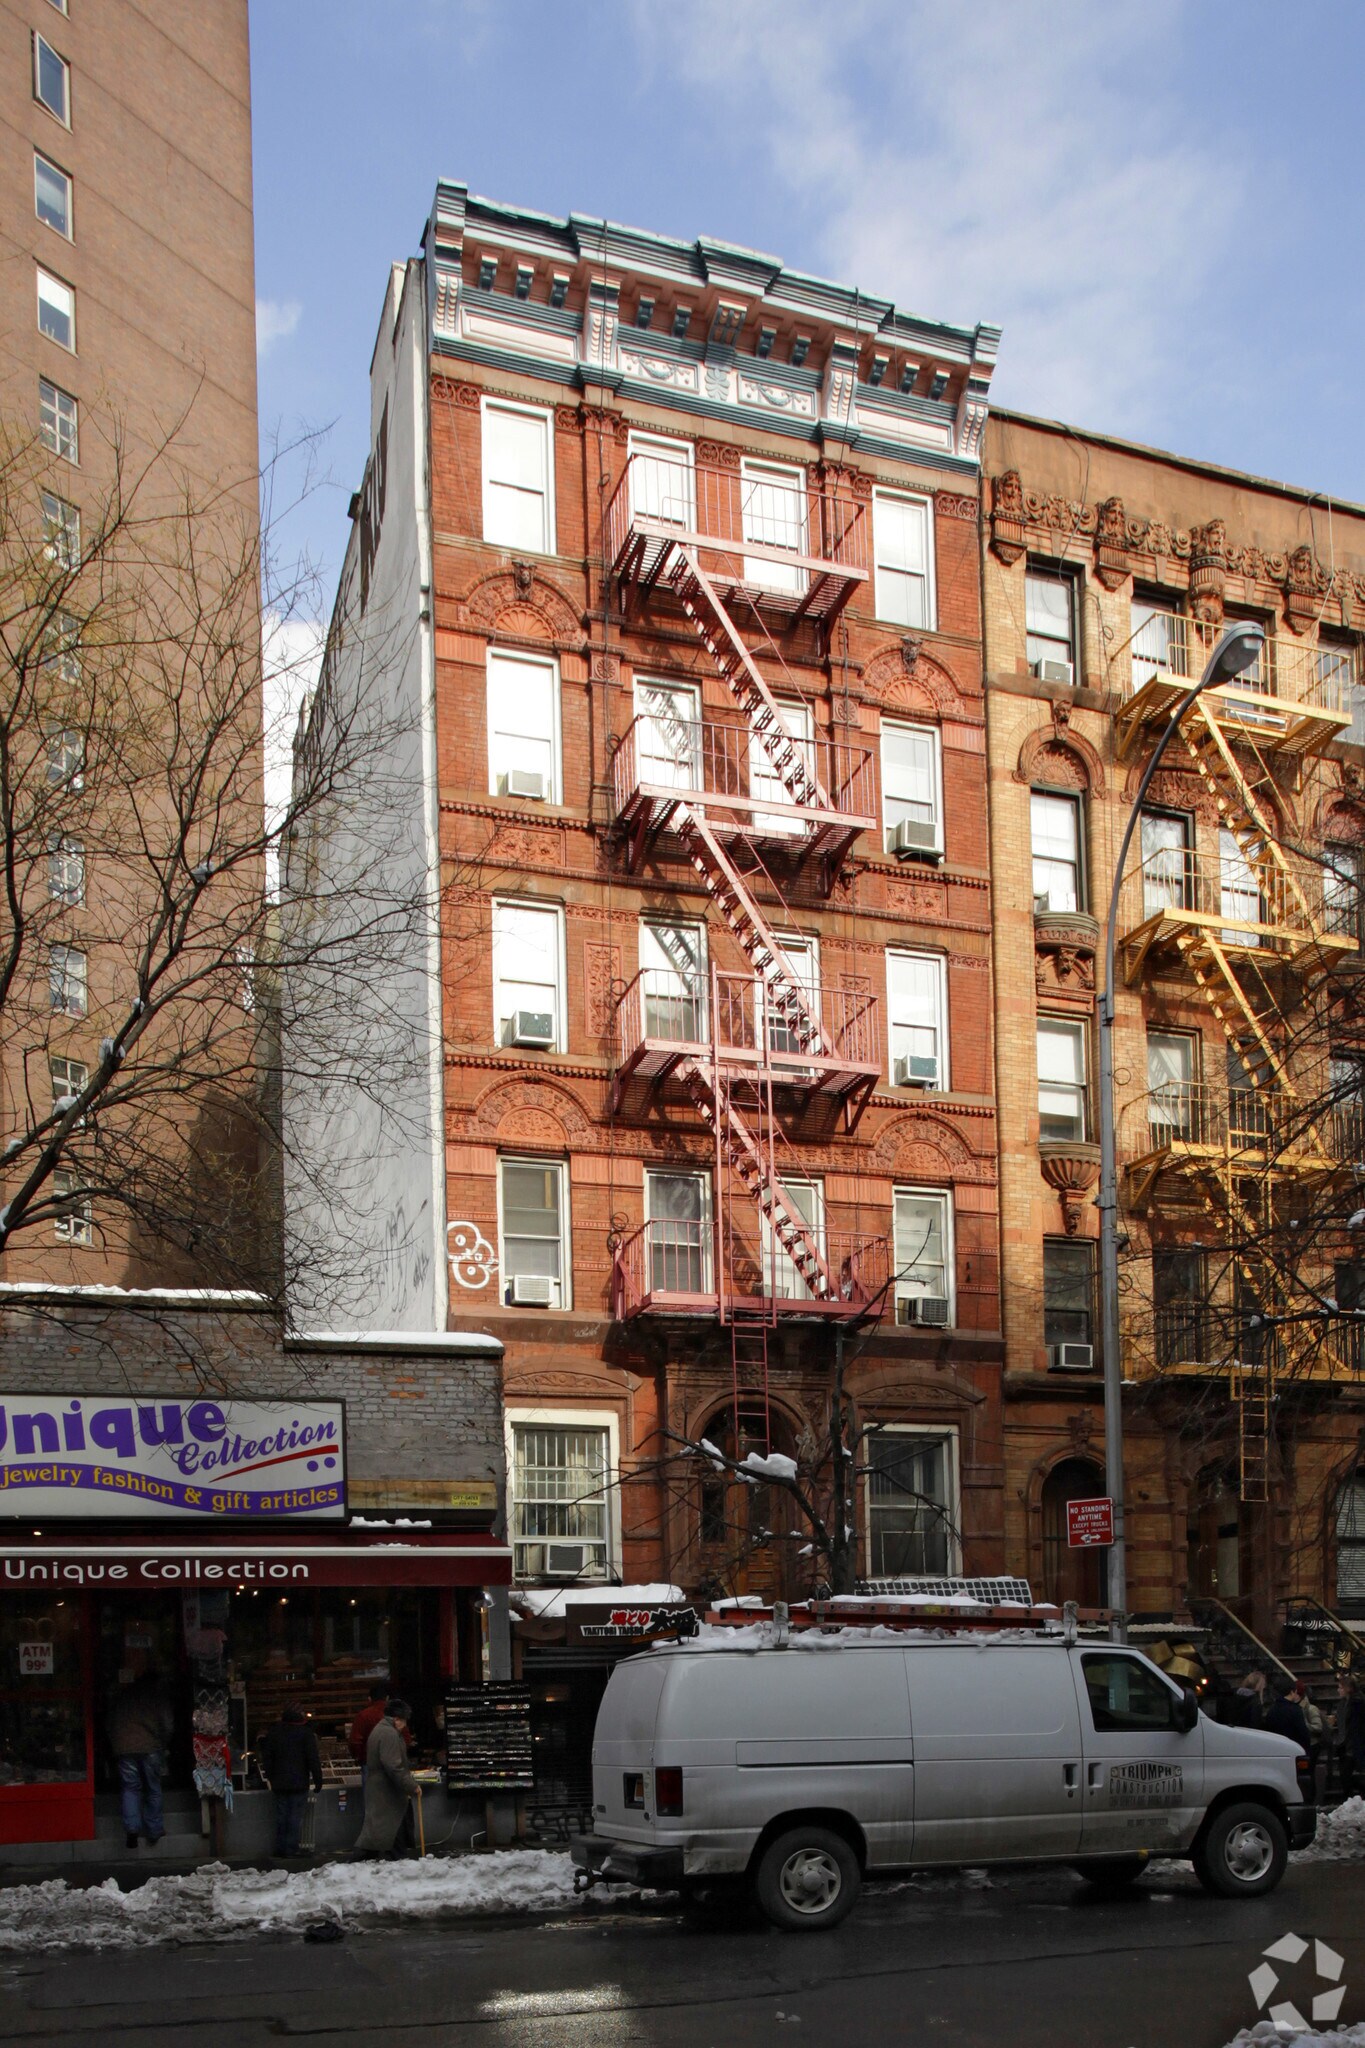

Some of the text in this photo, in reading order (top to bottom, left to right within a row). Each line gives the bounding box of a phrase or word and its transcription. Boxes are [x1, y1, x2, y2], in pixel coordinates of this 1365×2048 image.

[0, 1400, 227, 1457] nique
[172, 1419, 337, 1476] Collection
[0, 1465, 339, 1512] jewelry fashion & gift articles
[1077, 1513, 1102, 1521] ANYTIME
[1081, 1504, 1109, 1513] STANDING
[4, 1559, 310, 1583] Unique Collection
[22, 1646, 51, 1657] ATM
[26, 1659, 47, 1671] 99¢
[1121, 1762, 1172, 1781] TRIUMPH
[1109, 1776, 1184, 1794] CONSTRUCTION
